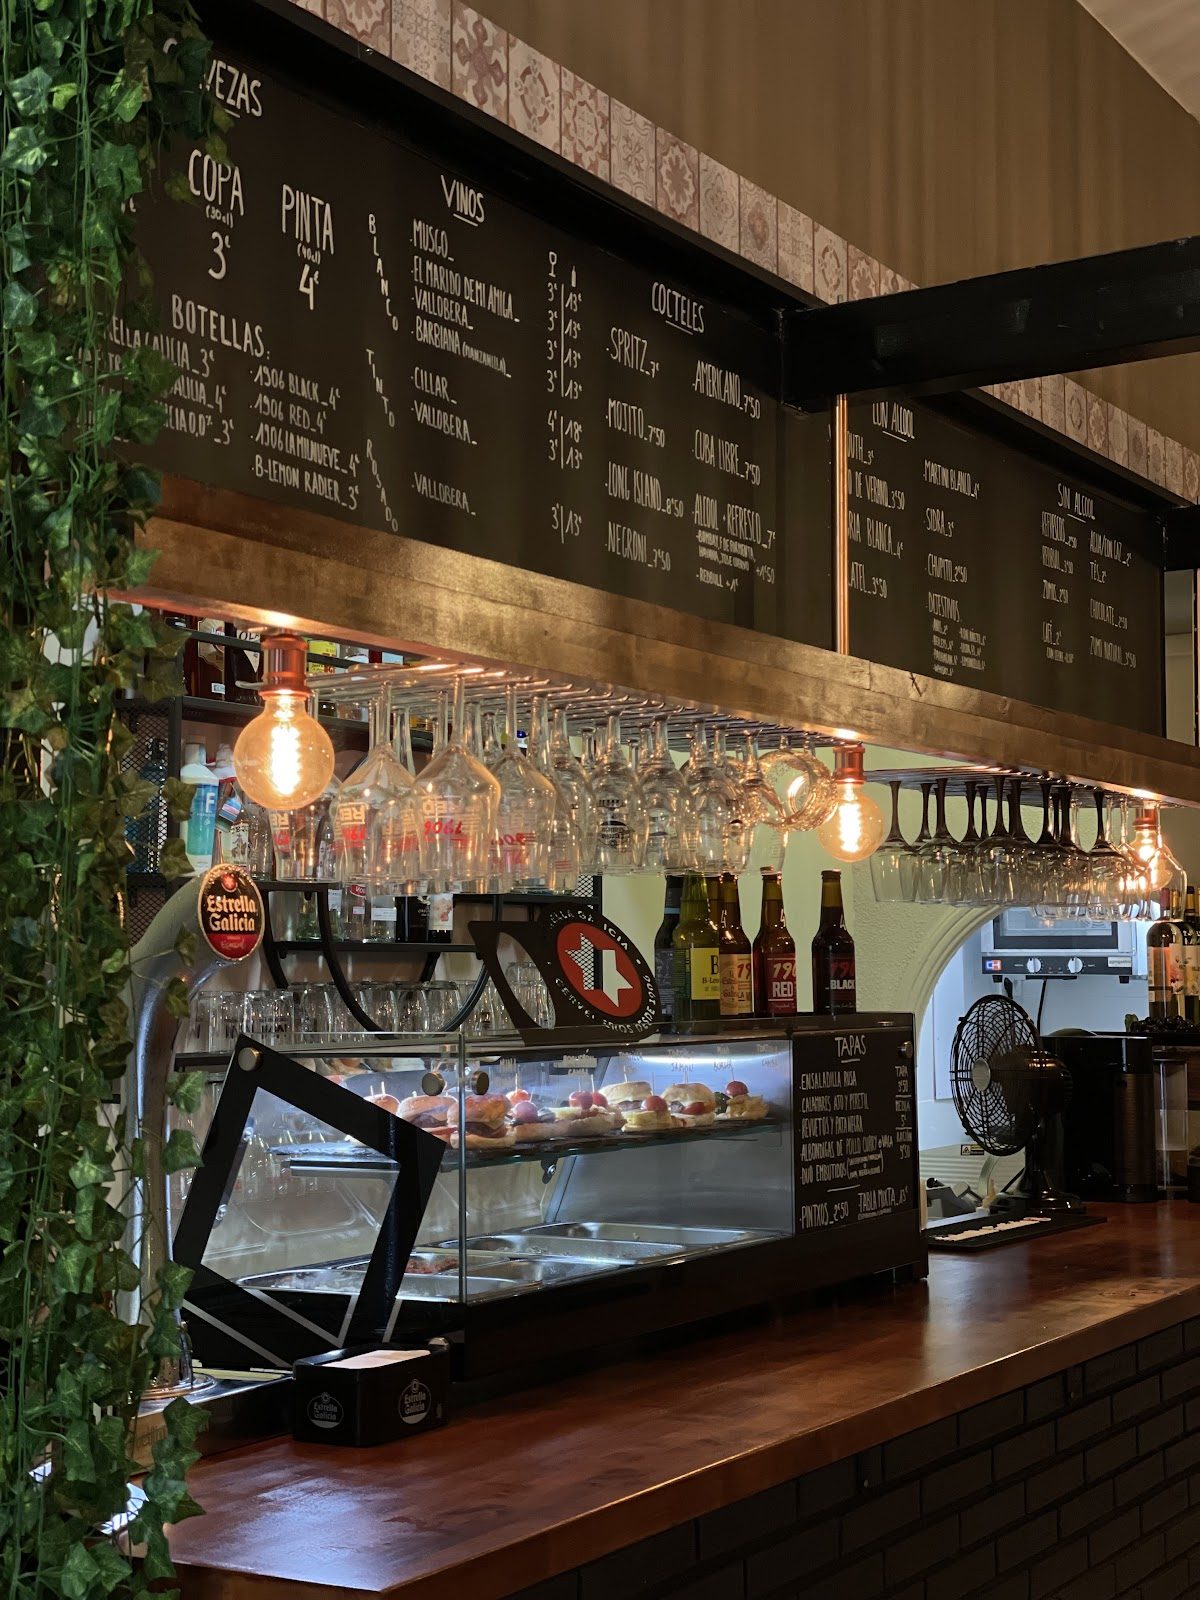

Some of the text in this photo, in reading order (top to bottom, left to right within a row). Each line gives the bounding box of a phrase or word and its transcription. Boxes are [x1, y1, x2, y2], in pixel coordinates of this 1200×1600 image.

[188, 149, 244, 217] COPA
[440, 174, 485, 223] VINOS
[282, 184, 334, 255] PINTA
[652, 281, 705, 334] COCTELES
[254, 365, 285, 391] 1906
[288, 372, 319, 403] BLACK
[254, 393, 284, 422] 1906
[289, 404, 311, 431] RED
[255, 422, 284, 452] 1906
[694, 429, 715, 469] CUBA
[608, 461, 631, 501] LONG
[206, 894, 258, 913] Estrella
[209, 912, 256, 932] Galicia
[772, 981, 793, 998] RED
[834, 1034, 867, 1057] TAPAS
